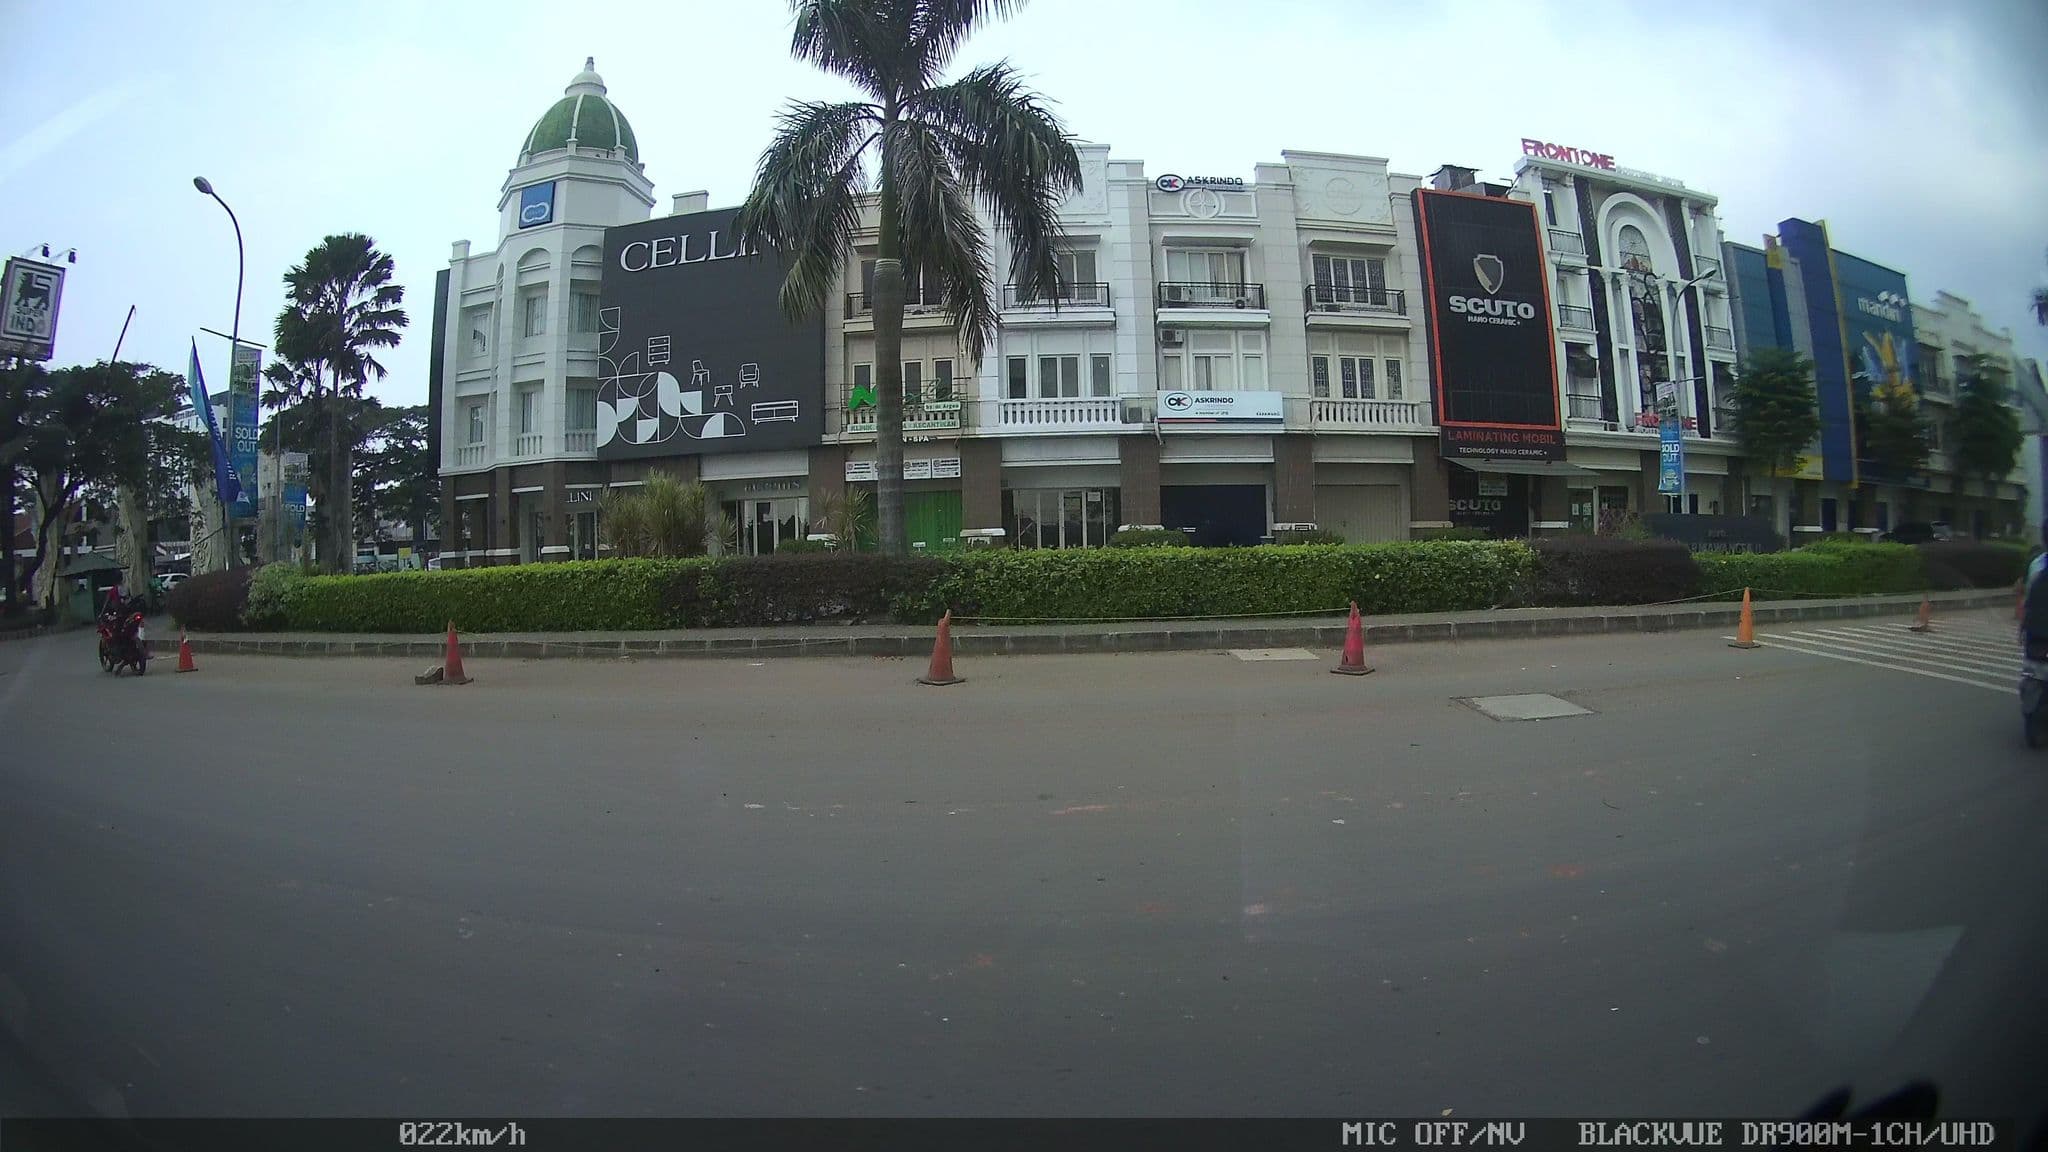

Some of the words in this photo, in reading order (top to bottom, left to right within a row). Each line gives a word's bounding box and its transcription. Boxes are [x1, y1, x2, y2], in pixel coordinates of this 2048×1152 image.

[1521, 138, 1580, 164] FRONT
[1580, 149, 1617, 172] ONE
[1187, 176, 1244, 186] ASKRINDO
[1449, 295, 1535, 319] SCUTO
[1467, 315, 1488, 324] NANO
[235, 427, 259, 440] SOLD
[1448, 430, 1519, 443] LAMINATING
[1523, 432, 1556, 445] MOBIL
[237, 440, 257, 452] OUT
[1662, 443, 1680, 453] SOLD
